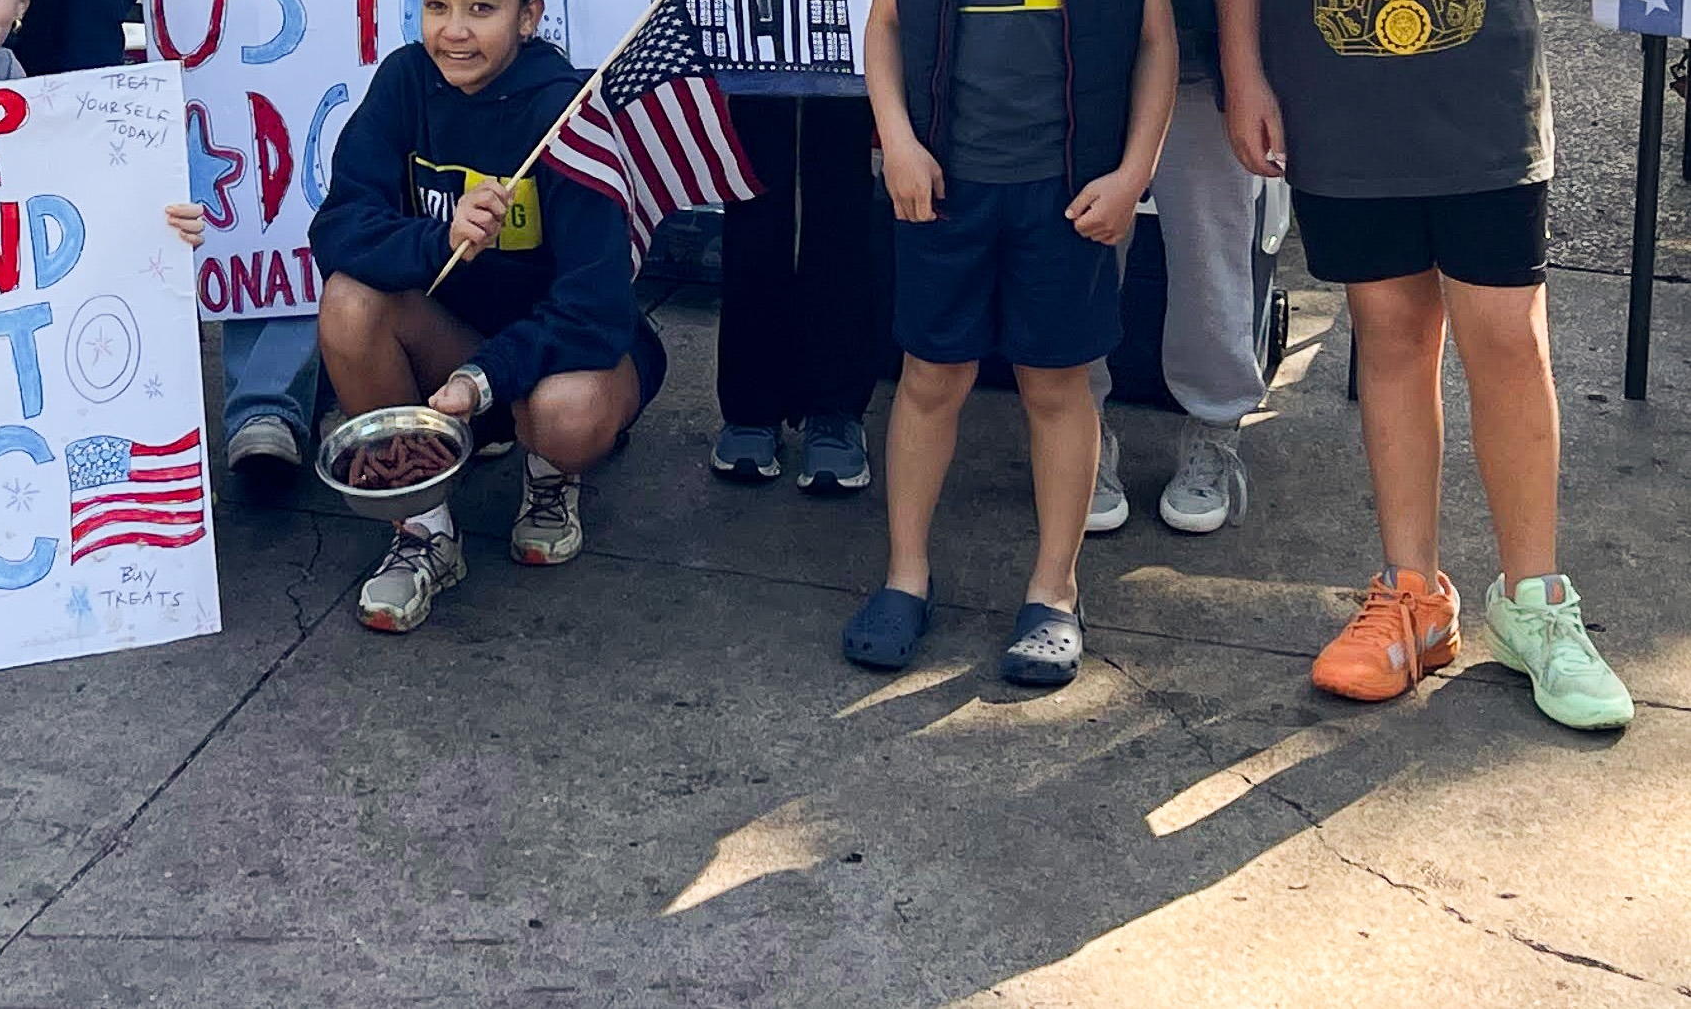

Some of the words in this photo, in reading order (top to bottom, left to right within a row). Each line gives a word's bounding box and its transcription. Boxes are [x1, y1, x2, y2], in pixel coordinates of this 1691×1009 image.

[101, 73, 167, 92] TREAT
[106, 119, 169, 148] TODAY!
[198, 246, 317, 313] ONAT
[99, 590, 184, 608] TREATS
